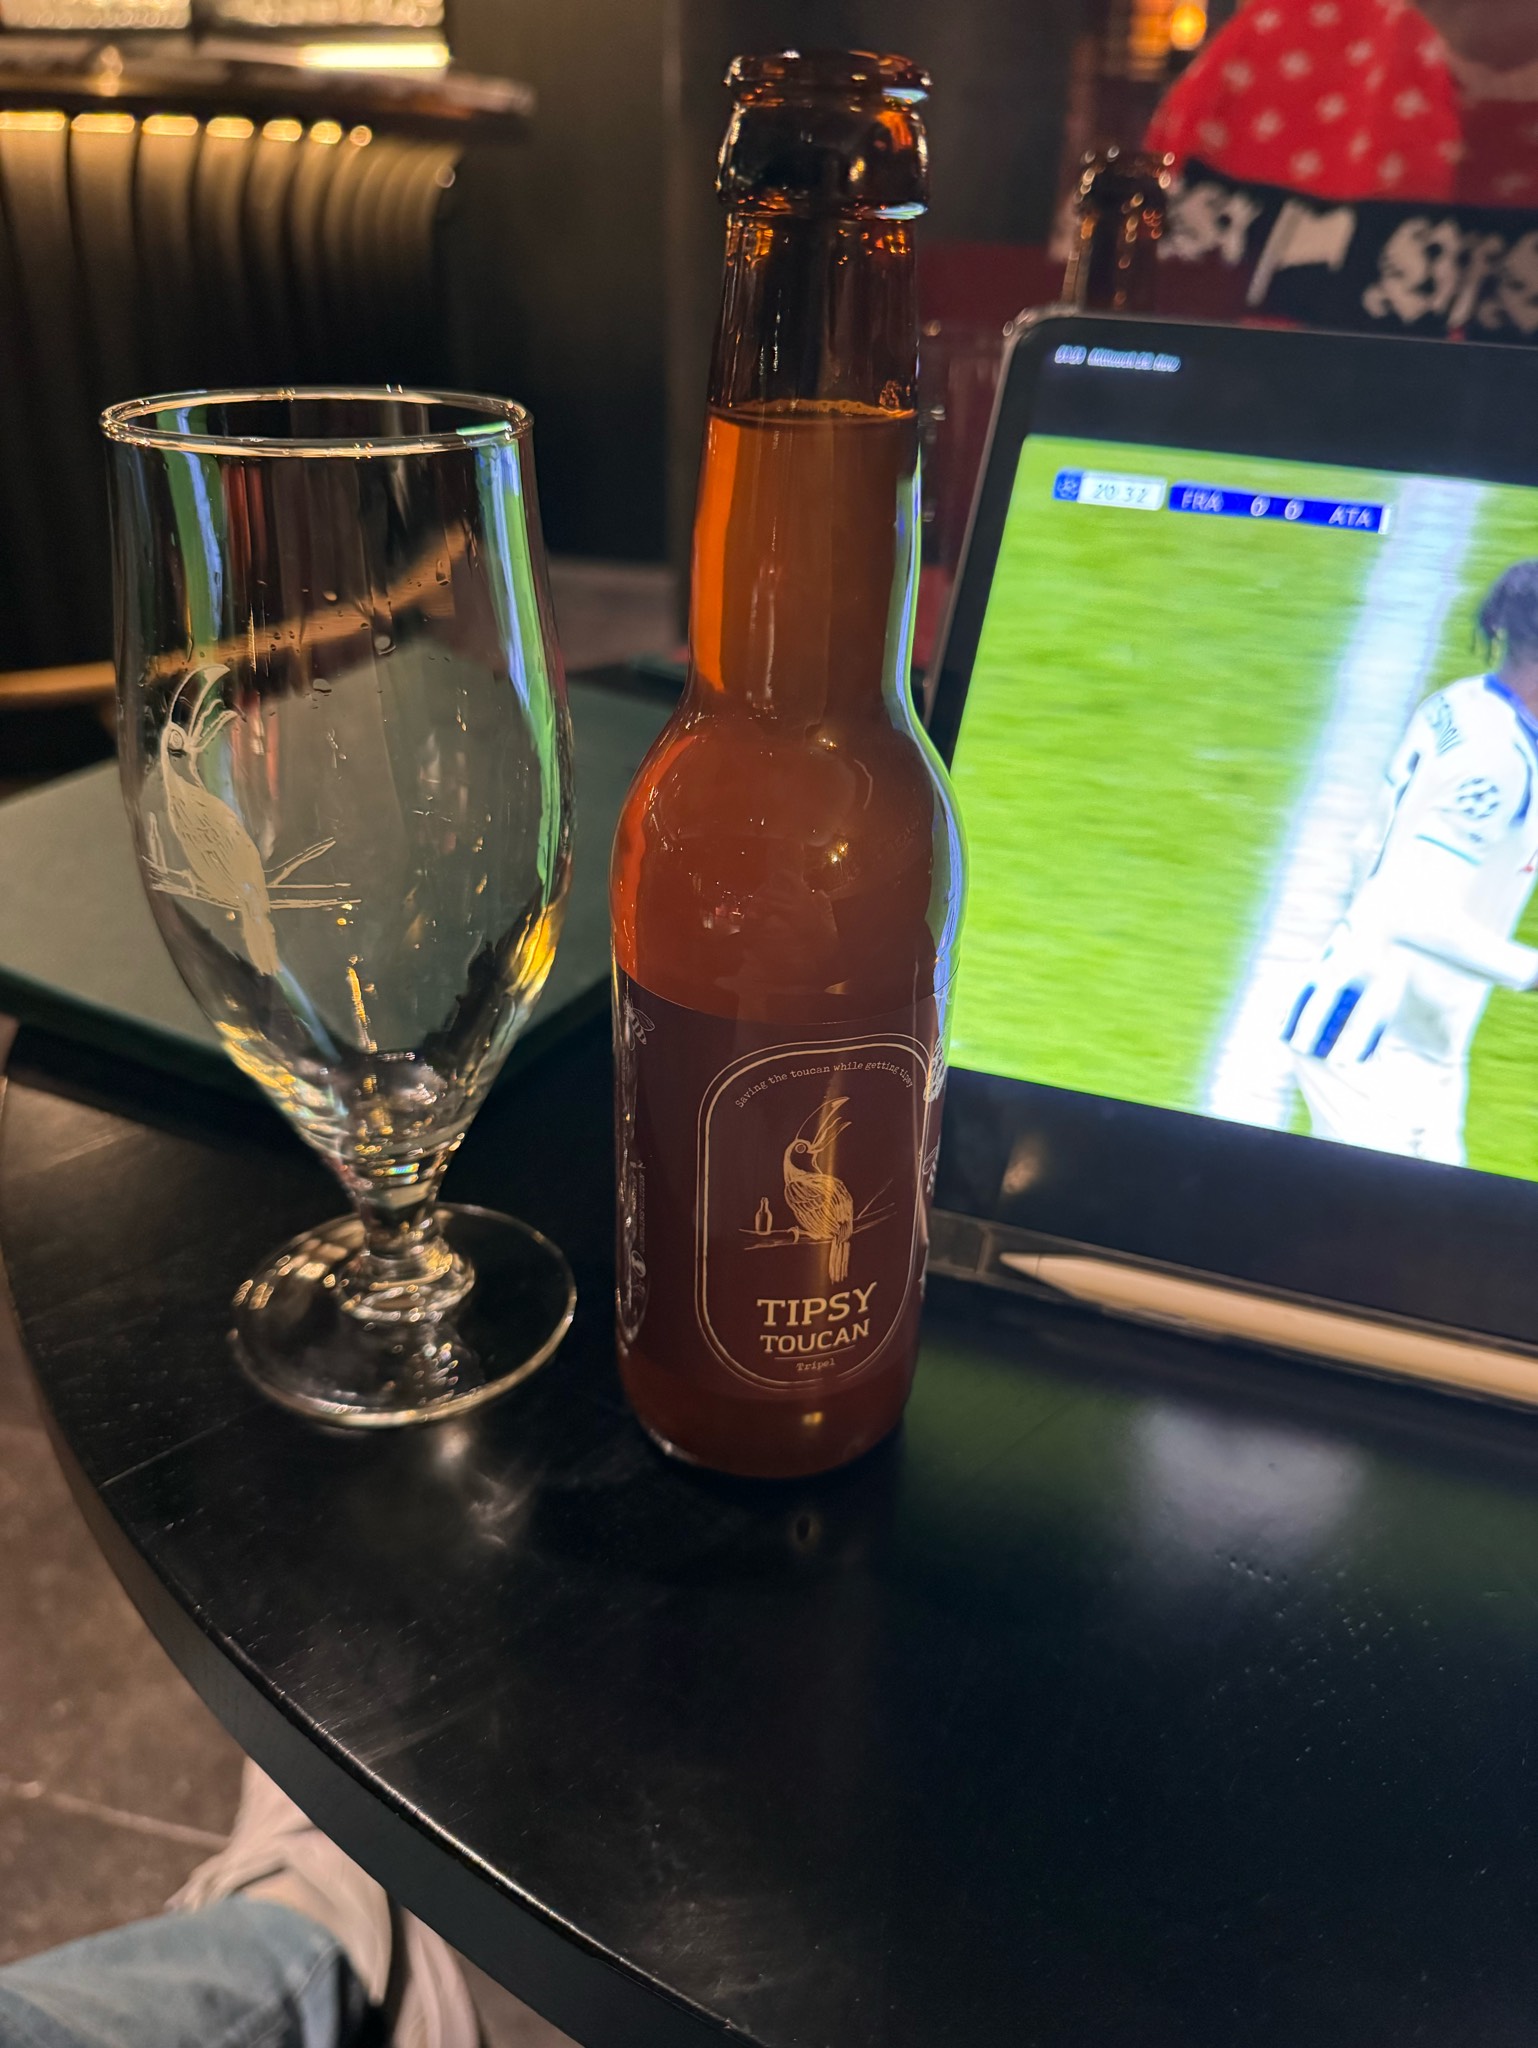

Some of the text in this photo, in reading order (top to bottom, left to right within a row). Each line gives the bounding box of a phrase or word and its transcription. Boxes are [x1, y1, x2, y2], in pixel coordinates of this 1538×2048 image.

[1180, 488, 1223, 512] FRA
[1328, 505, 1375, 528] ATA
[735, 1061, 913, 1108] Saving the toucan while getting tipsy
[757, 1281, 877, 1326] TIPSY
[760, 1318, 870, 1354] TOUCAN
[796, 1358, 836, 1371] Tripel
